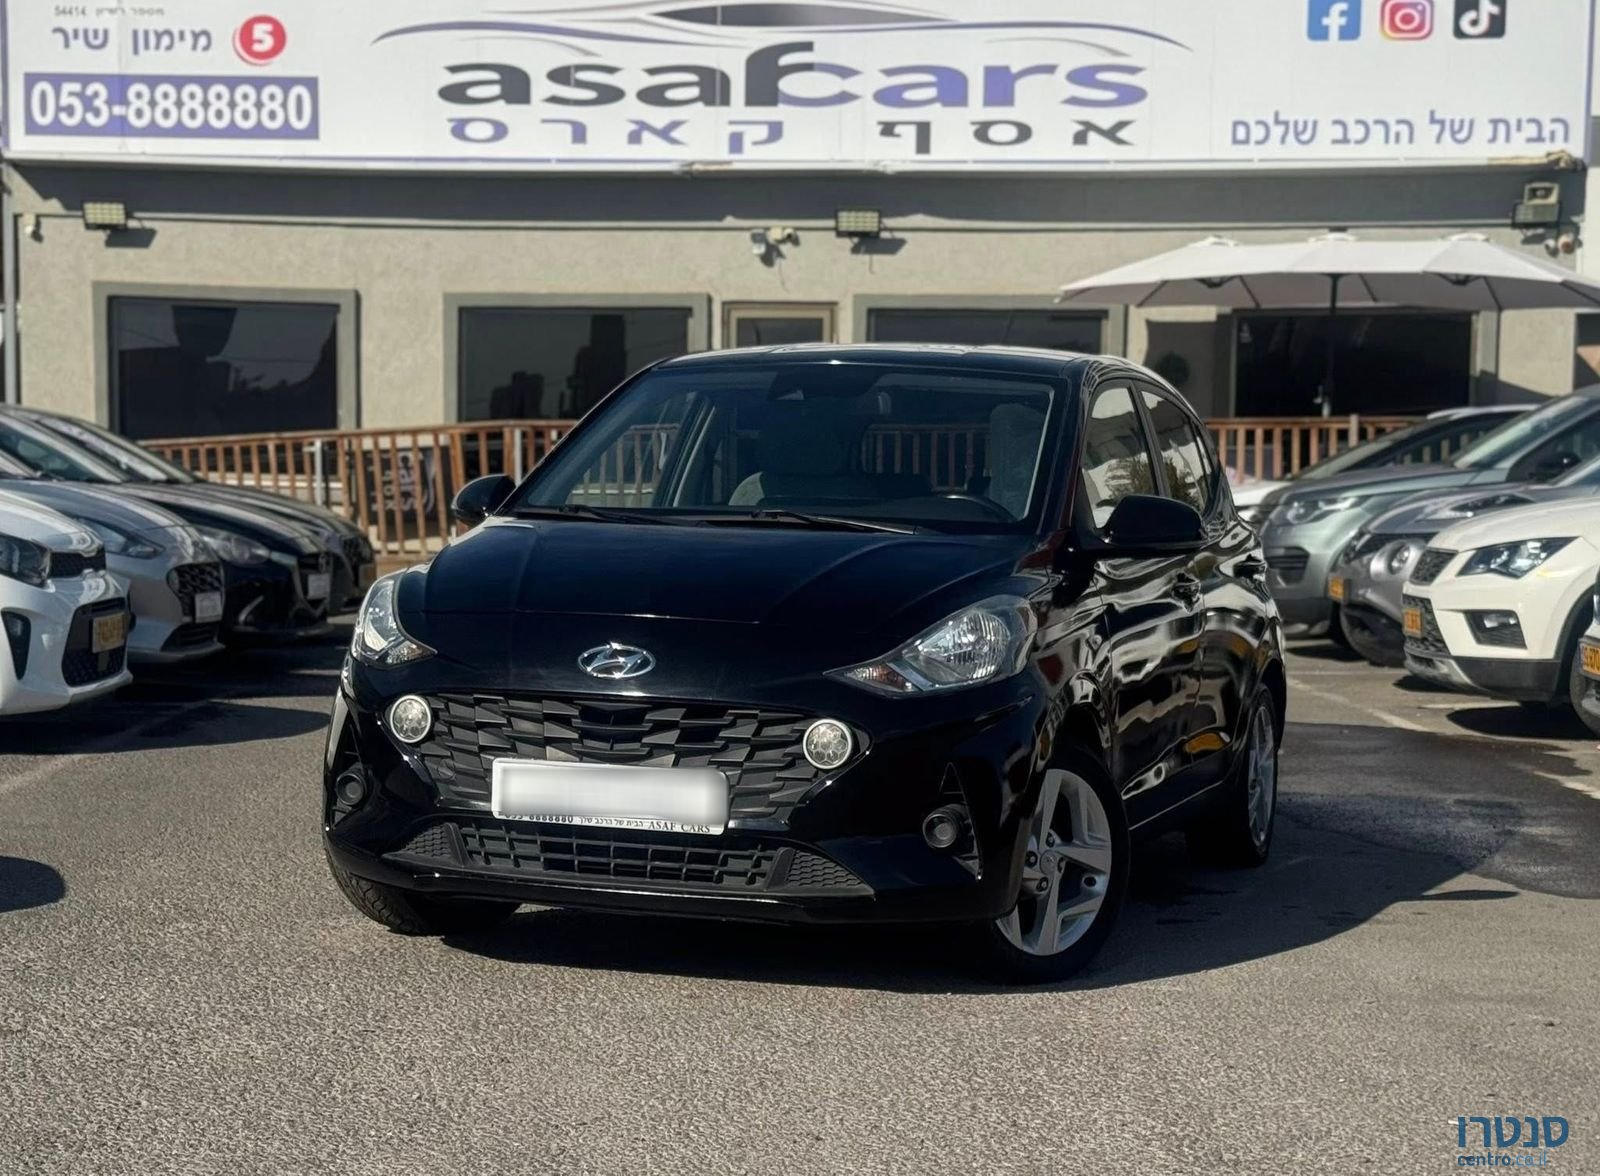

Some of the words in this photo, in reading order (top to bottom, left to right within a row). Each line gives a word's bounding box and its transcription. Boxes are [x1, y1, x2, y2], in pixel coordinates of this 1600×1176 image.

[51, 27, 109, 50] שיר
[132, 28, 212, 55] מימון
[250, 23, 276, 52] 5
[30, 81, 312, 130] 053-8888880
[446, 117, 784, 154] קארס
[877, 119, 1137, 155] אסף
[1231, 110, 1318, 146] שלכם
[1330, 119, 1414, 145] הרכב
[1429, 110, 1475, 144] של
[1487, 116, 1571, 145] הבית
[648, 821, 676, 831] ASAF
[681, 823, 710, 833] CARS
